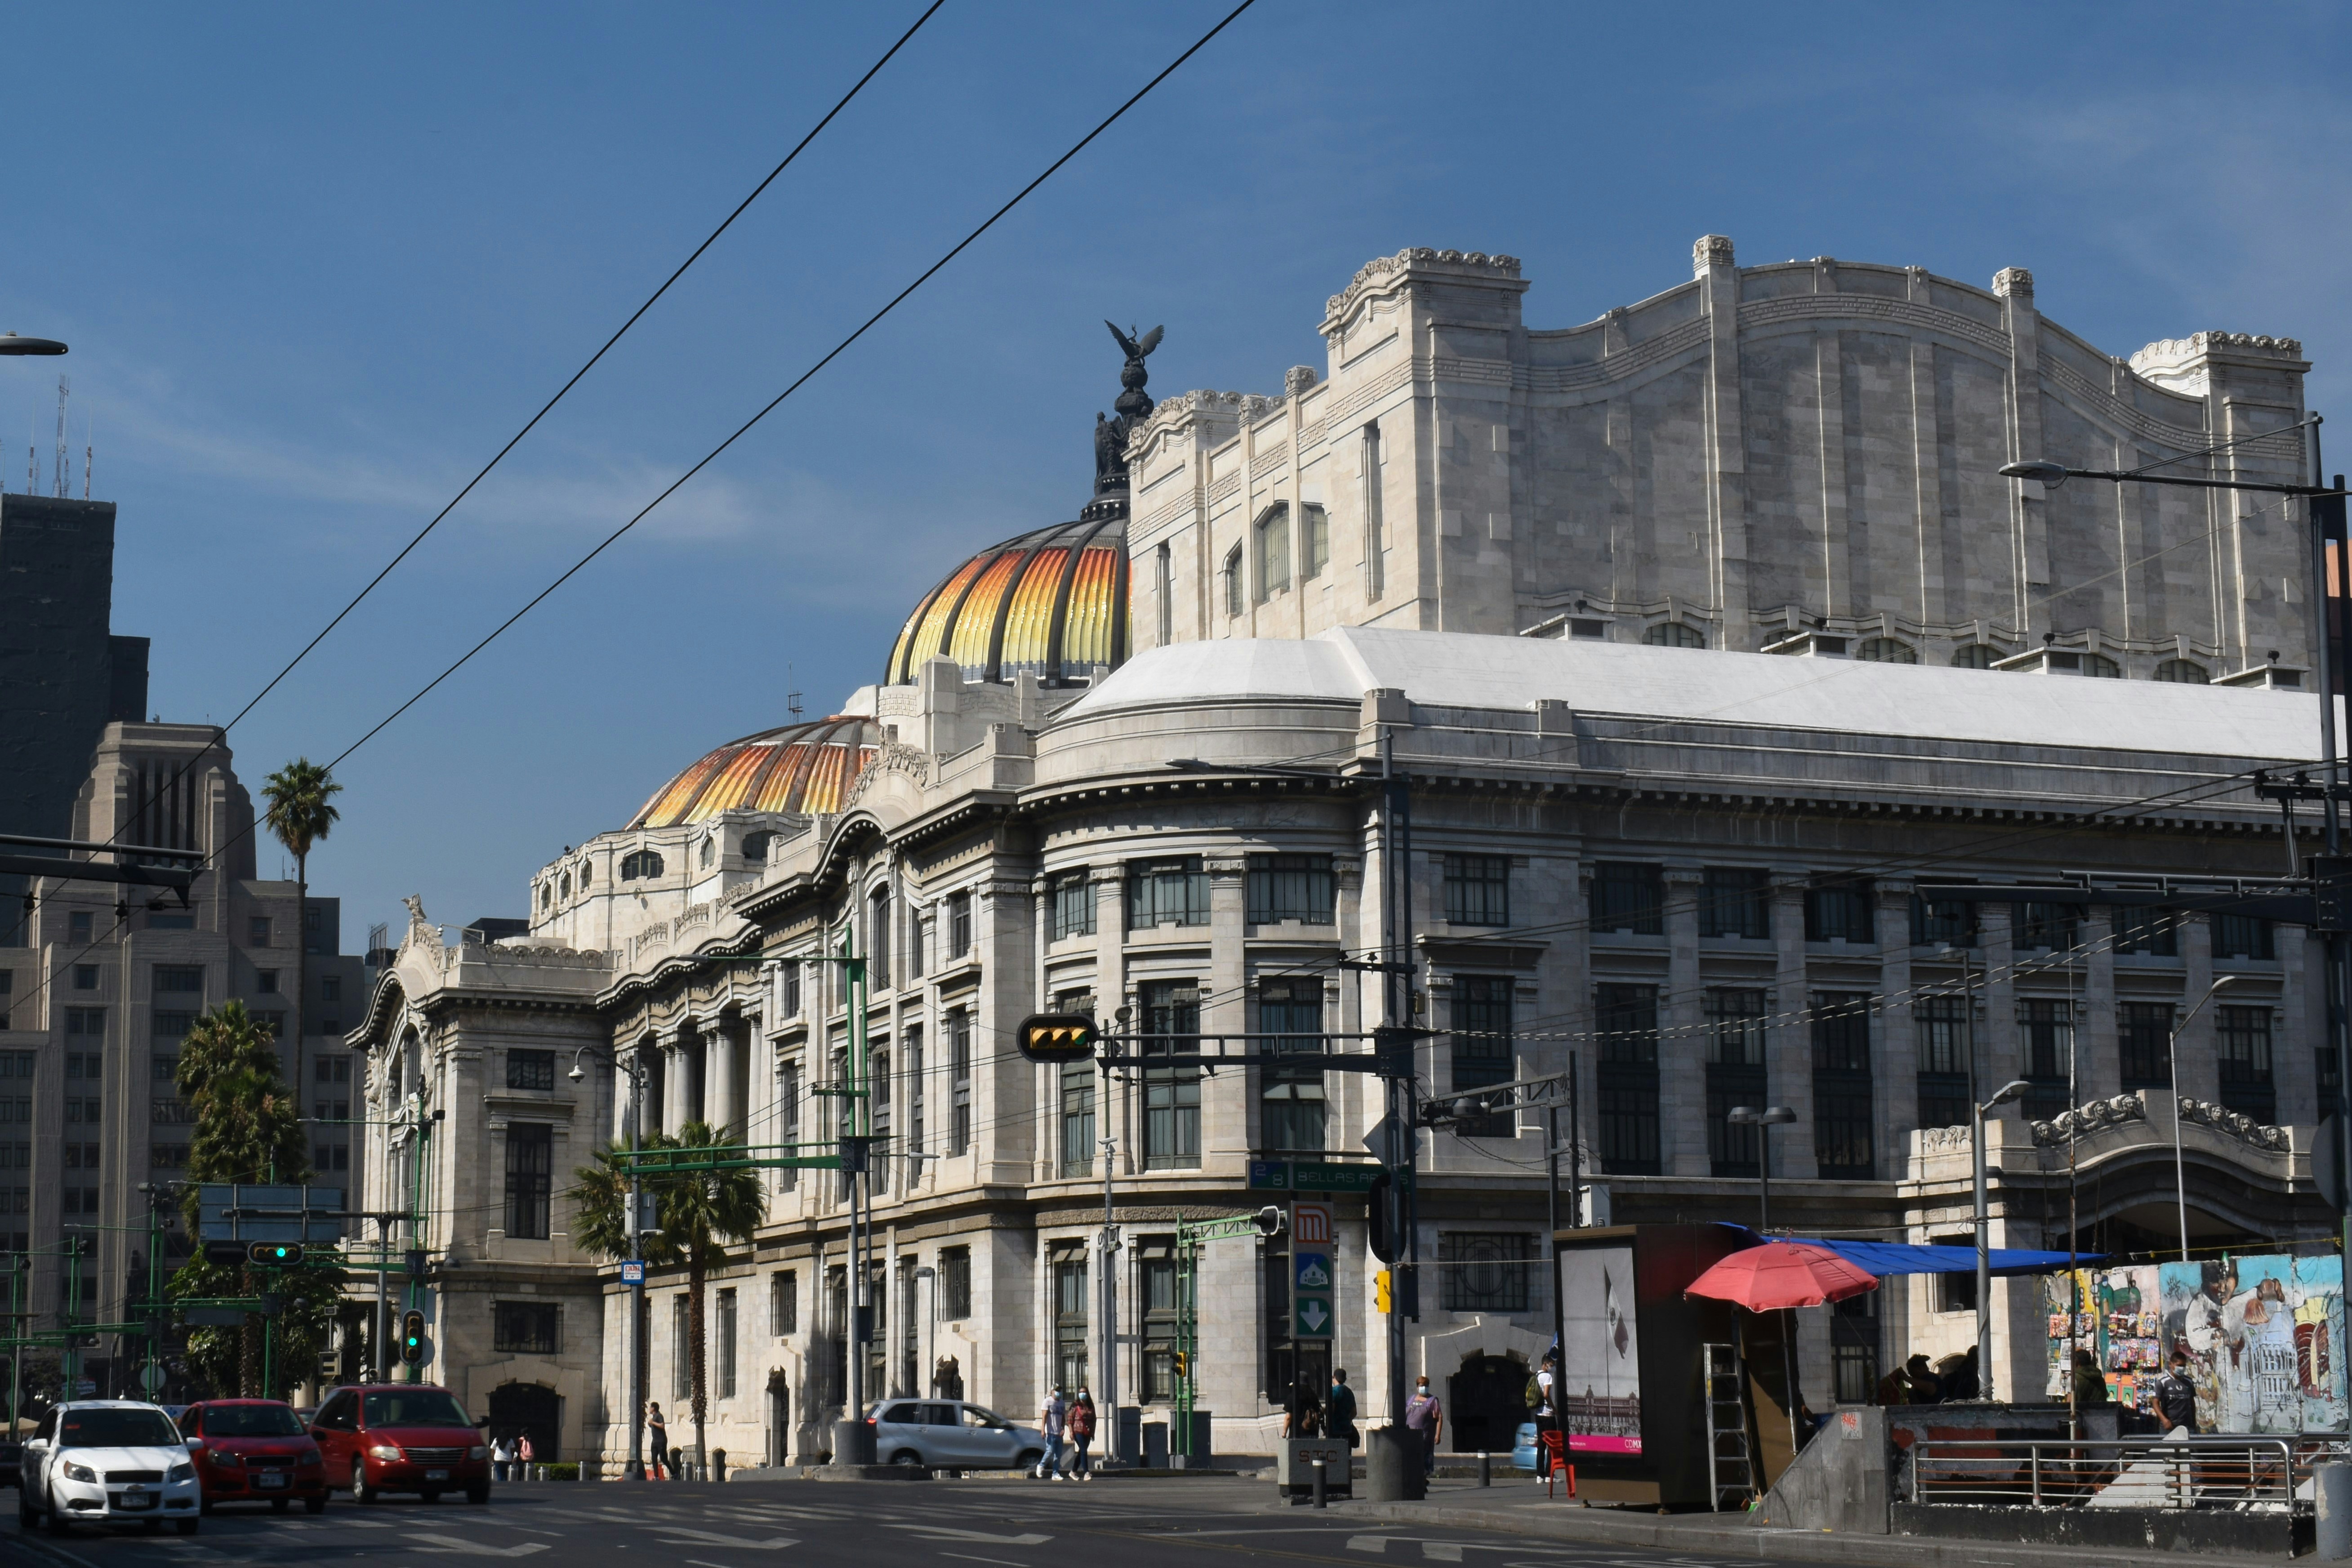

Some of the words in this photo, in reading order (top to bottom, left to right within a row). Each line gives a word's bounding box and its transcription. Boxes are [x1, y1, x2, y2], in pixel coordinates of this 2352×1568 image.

[1255, 1164, 1266, 1176] 2
[1273, 1174, 1283, 1185] 8
[1298, 1172, 1355, 1183] BELLAS
[1625, 1439, 1642, 1448] CDMX
